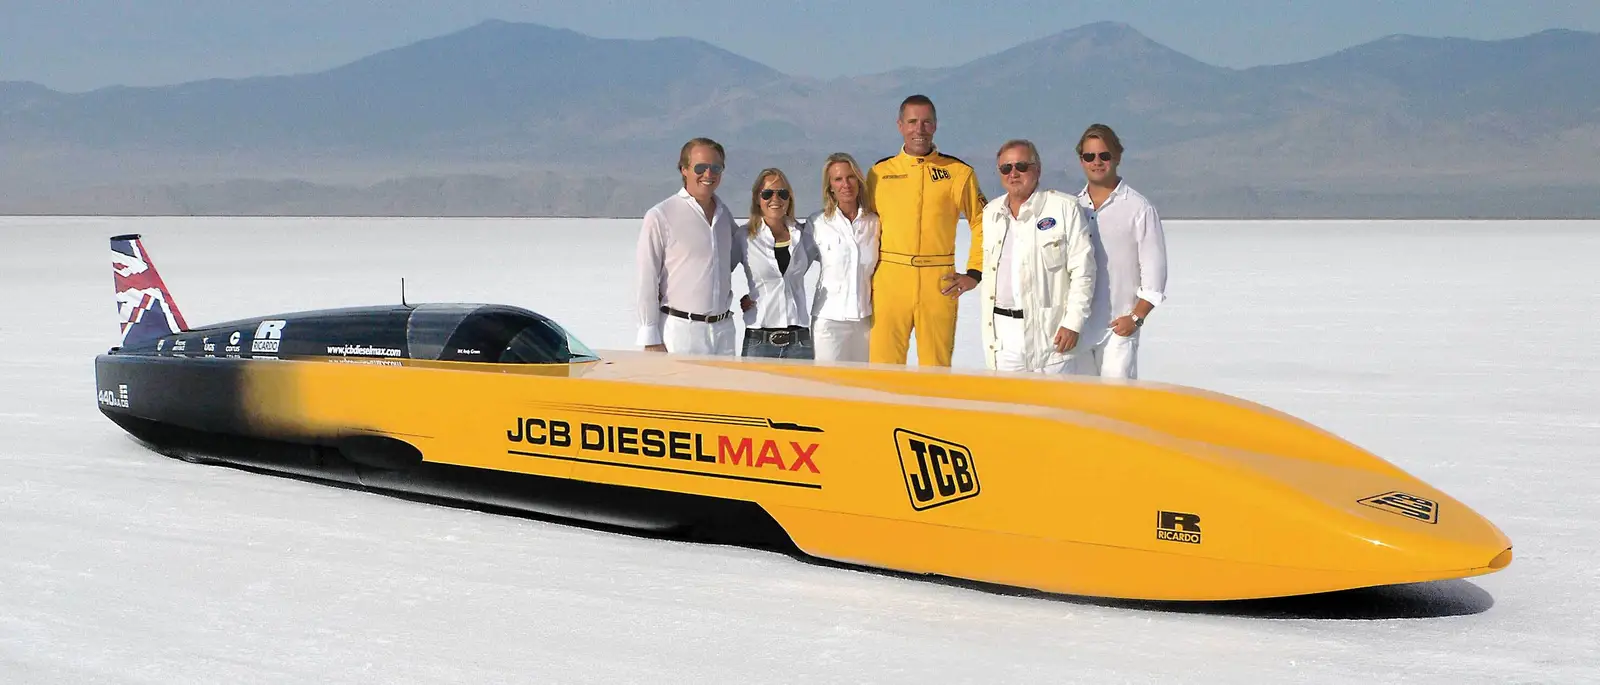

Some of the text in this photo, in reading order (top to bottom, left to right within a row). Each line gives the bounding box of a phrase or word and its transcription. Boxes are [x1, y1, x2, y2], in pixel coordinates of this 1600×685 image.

[931, 167, 951, 181] JCB
[254, 320, 287, 339] R
[252, 340, 279, 351] RICARDO
[326, 344, 401, 357] www.jcbdieselmax.com
[507, 417, 571, 447] JCB
[908, 438, 974, 502] JCB
[1370, 493, 1433, 520] JCB
[1158, 530, 1200, 543] RICARDO
